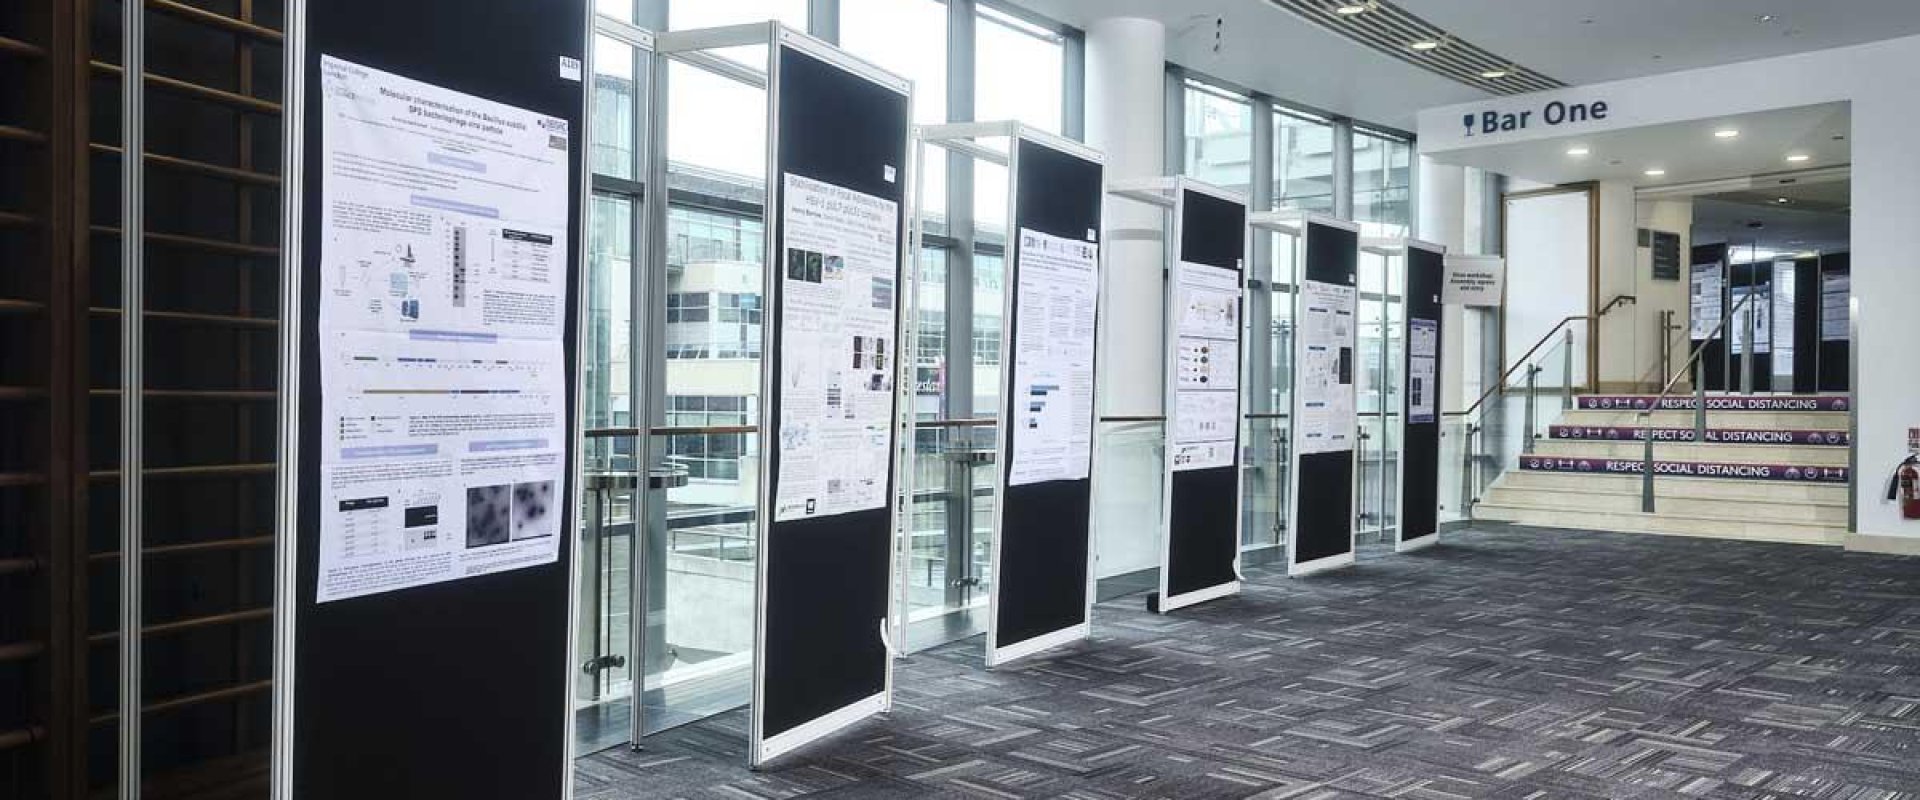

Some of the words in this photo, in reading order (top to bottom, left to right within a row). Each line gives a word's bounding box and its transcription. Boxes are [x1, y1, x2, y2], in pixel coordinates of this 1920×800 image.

[1482, 110, 1532, 134] Bar
[1544, 100, 1608, 125] One
[1662, 399, 1697, 409] RESPEC
[1706, 399, 1744, 409] SOCIAL
[1748, 399, 1817, 409] DISTANCING
[1633, 429, 1677, 440] REPECT
[1679, 430, 1719, 441] SOAL
[1723, 431, 1793, 442] DISTANCING
[1606, 460, 1646, 472] RESPEC
[1654, 462, 1694, 473] SOCIAL
[1698, 463, 1770, 477] DISTANCING
